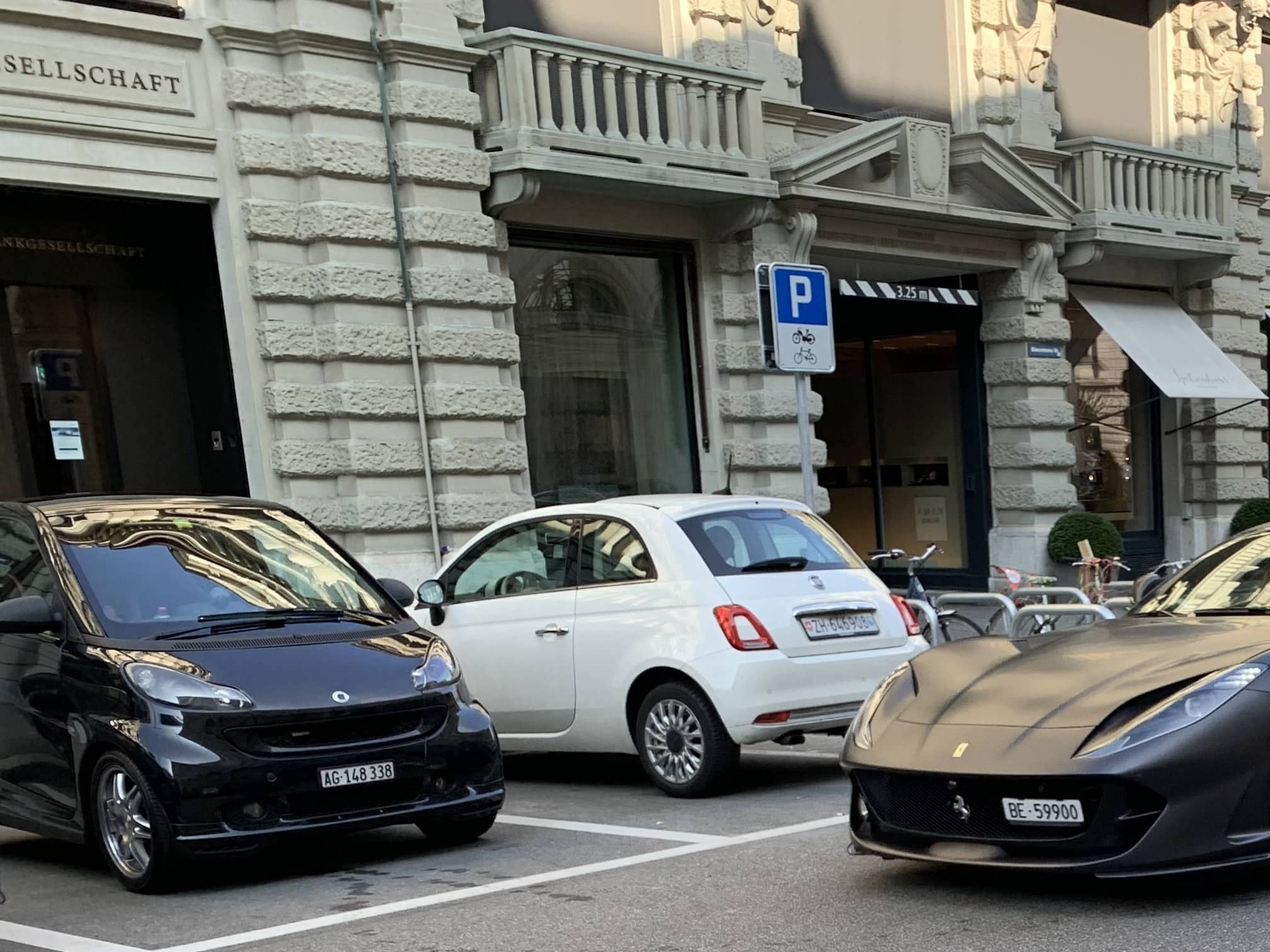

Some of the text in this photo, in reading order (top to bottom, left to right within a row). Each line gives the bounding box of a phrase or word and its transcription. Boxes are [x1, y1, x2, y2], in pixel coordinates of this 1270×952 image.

[0, 54, 180, 94] SELLSCHAFT
[789, 275, 812, 318] P
[896, 286, 928, 300] 3.25 m
